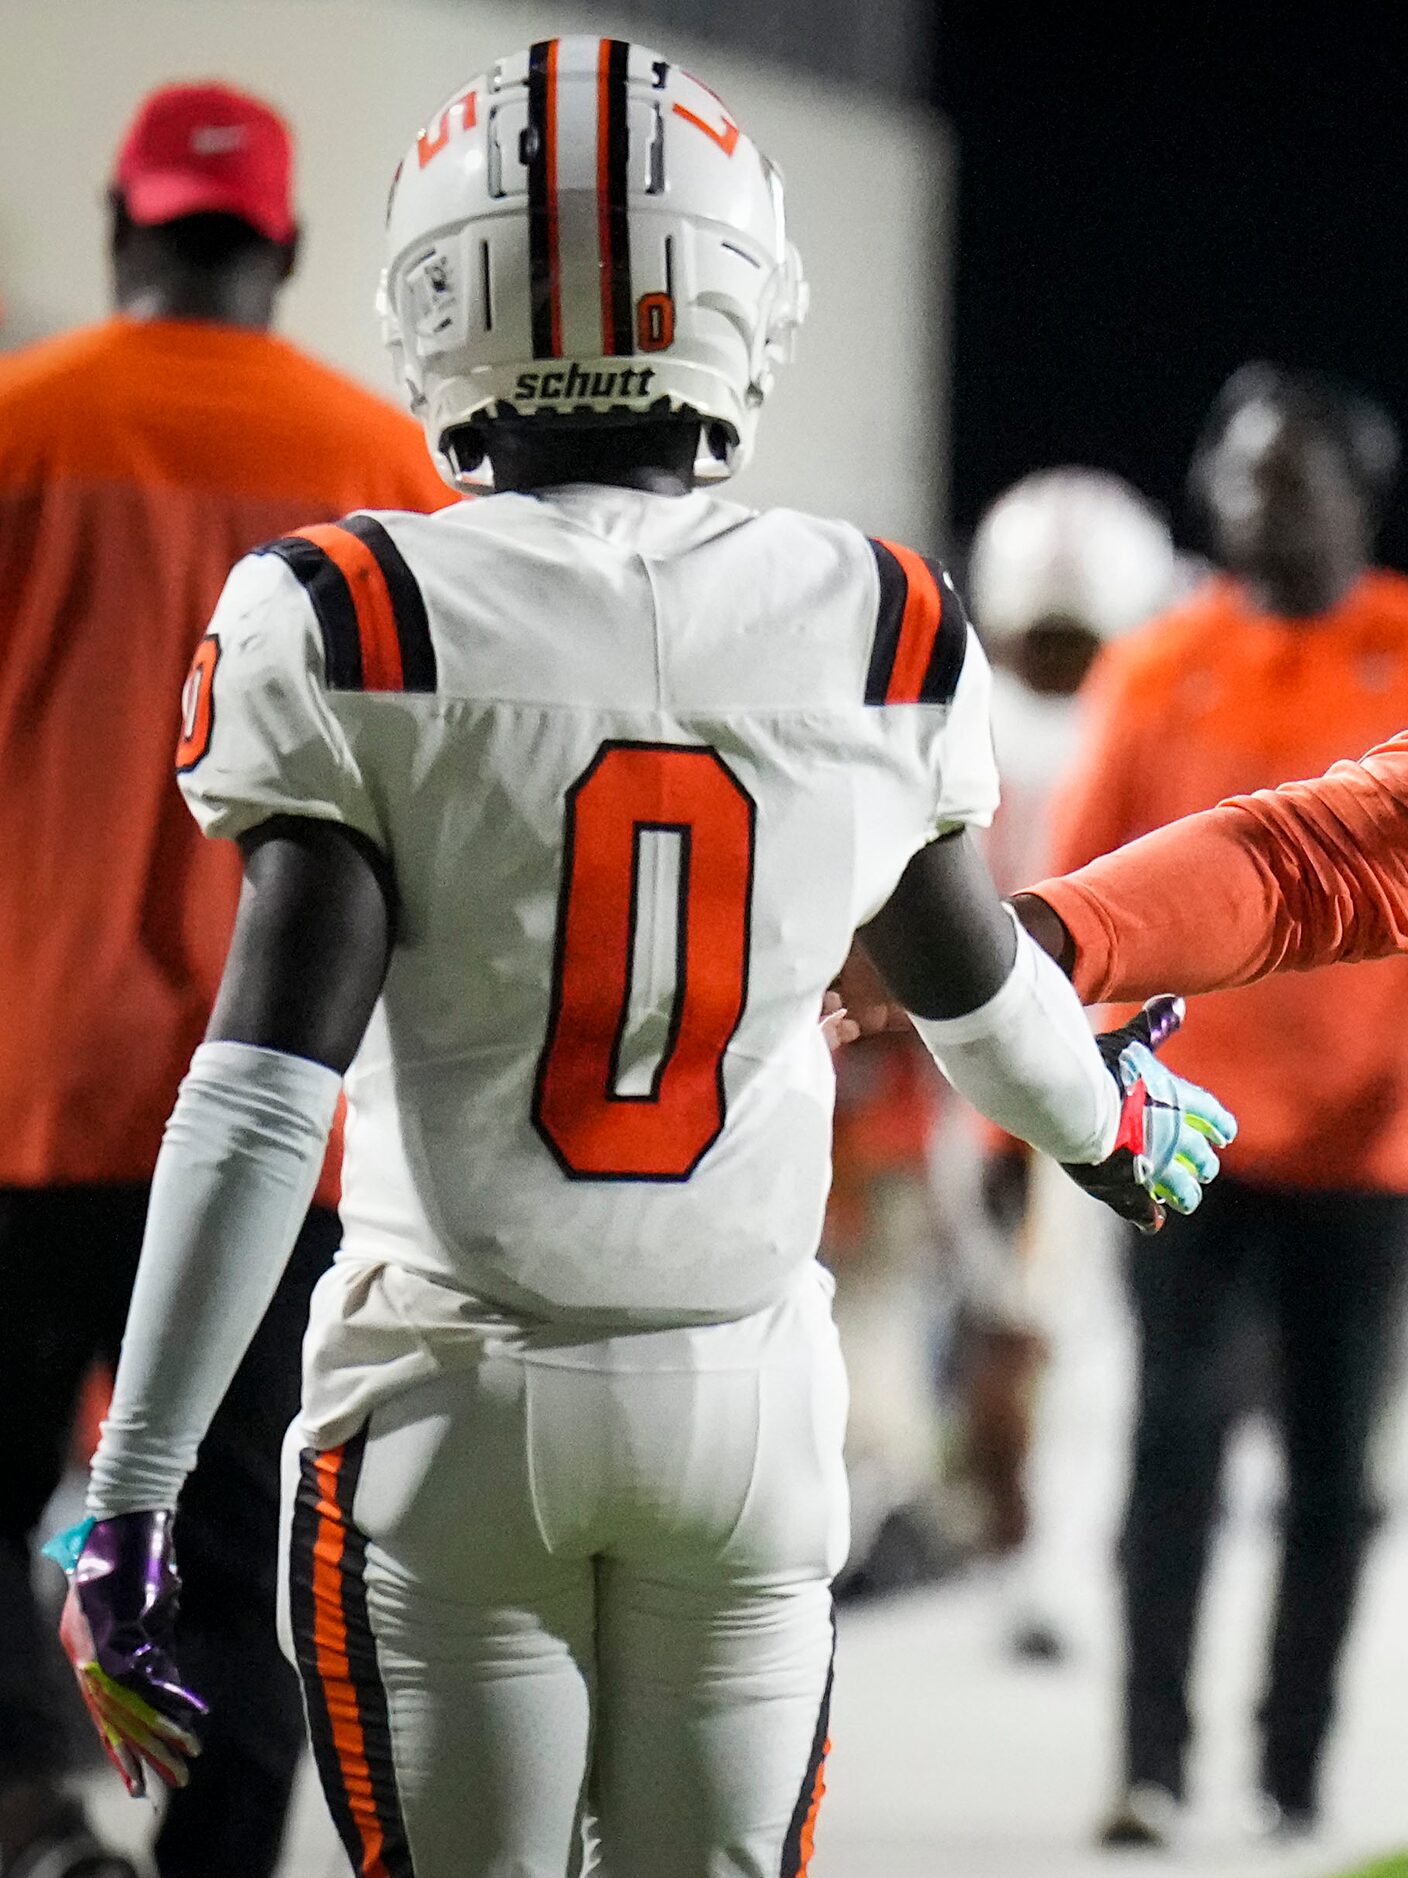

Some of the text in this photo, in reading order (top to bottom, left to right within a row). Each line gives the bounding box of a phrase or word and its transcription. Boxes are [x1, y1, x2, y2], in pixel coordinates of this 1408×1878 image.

[636, 292, 675, 352] 0
[514, 362, 656, 399] schutt
[531, 740, 757, 1181] 0
